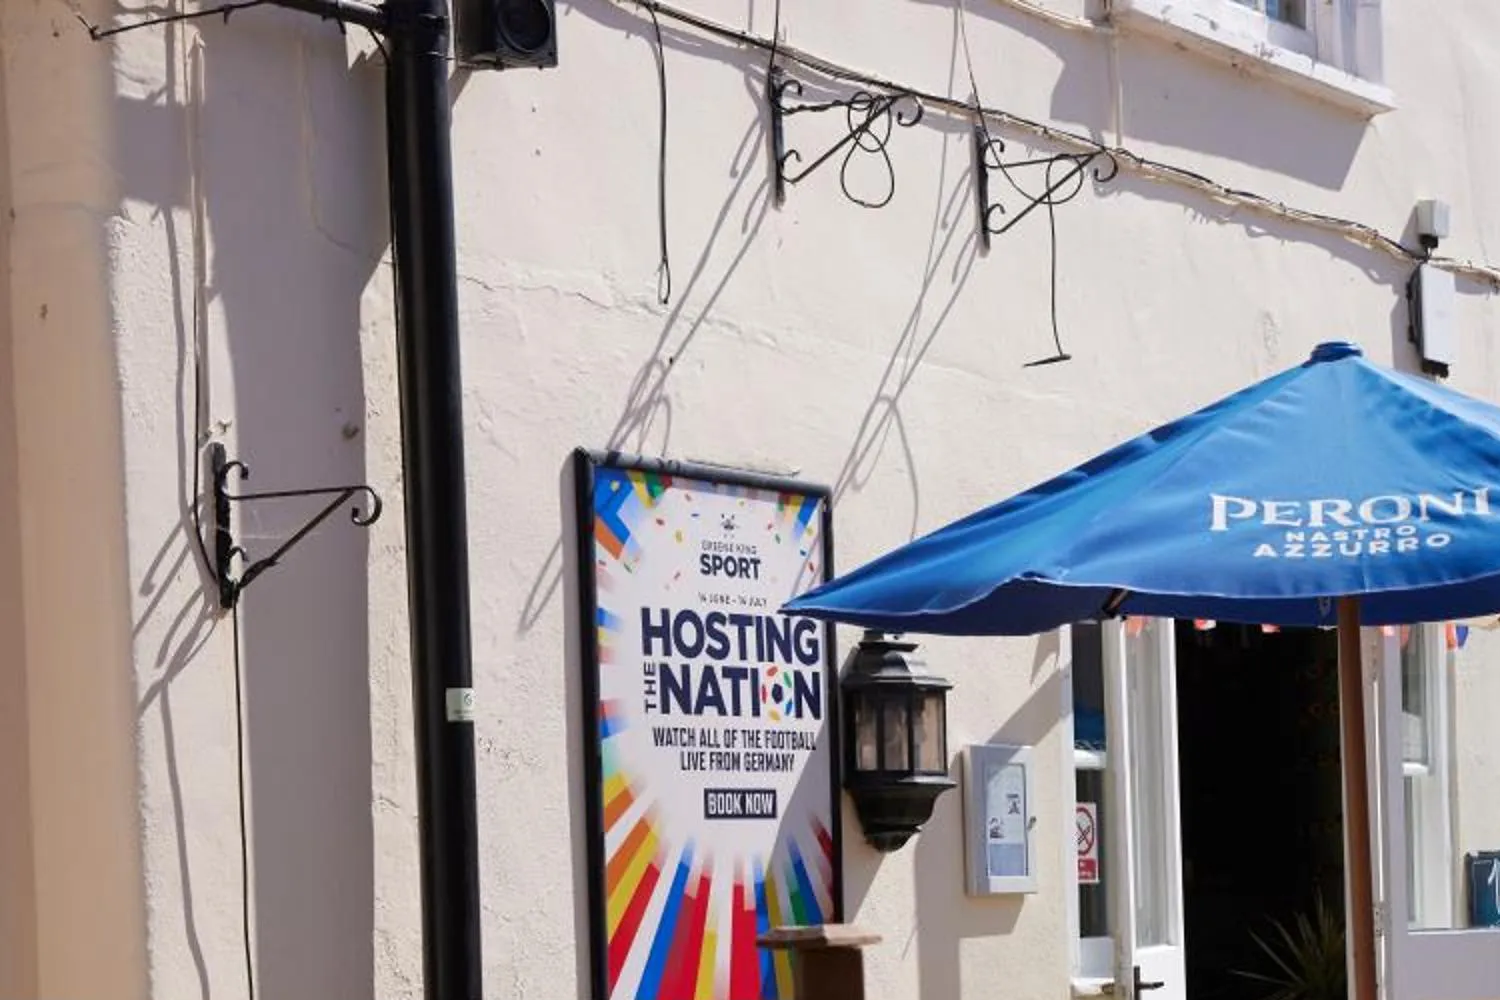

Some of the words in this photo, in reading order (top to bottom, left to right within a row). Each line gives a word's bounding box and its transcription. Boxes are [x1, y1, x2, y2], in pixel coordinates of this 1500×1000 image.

[1208, 486, 1492, 531] PERONI
[1253, 533, 1450, 558] AZZURRO
[1285, 525, 1416, 543] NASTRO
[700, 553, 761, 580] SPORT
[640, 607, 820, 665] HOSTING
[643, 662, 656, 714] THE
[653, 727, 696, 747] WATCH
[700, 729, 721, 748] ALL
[724, 729, 738, 748] OF
[741, 730, 761, 749] THE
[765, 730, 817, 751] FOOTBALL
[680, 751, 706, 771] LIVE
[709, 752, 741, 771] FROM
[744, 753, 796, 772] GERMANY
[708, 792, 743, 815] BOOK
[745, 793, 775, 814] NOW
